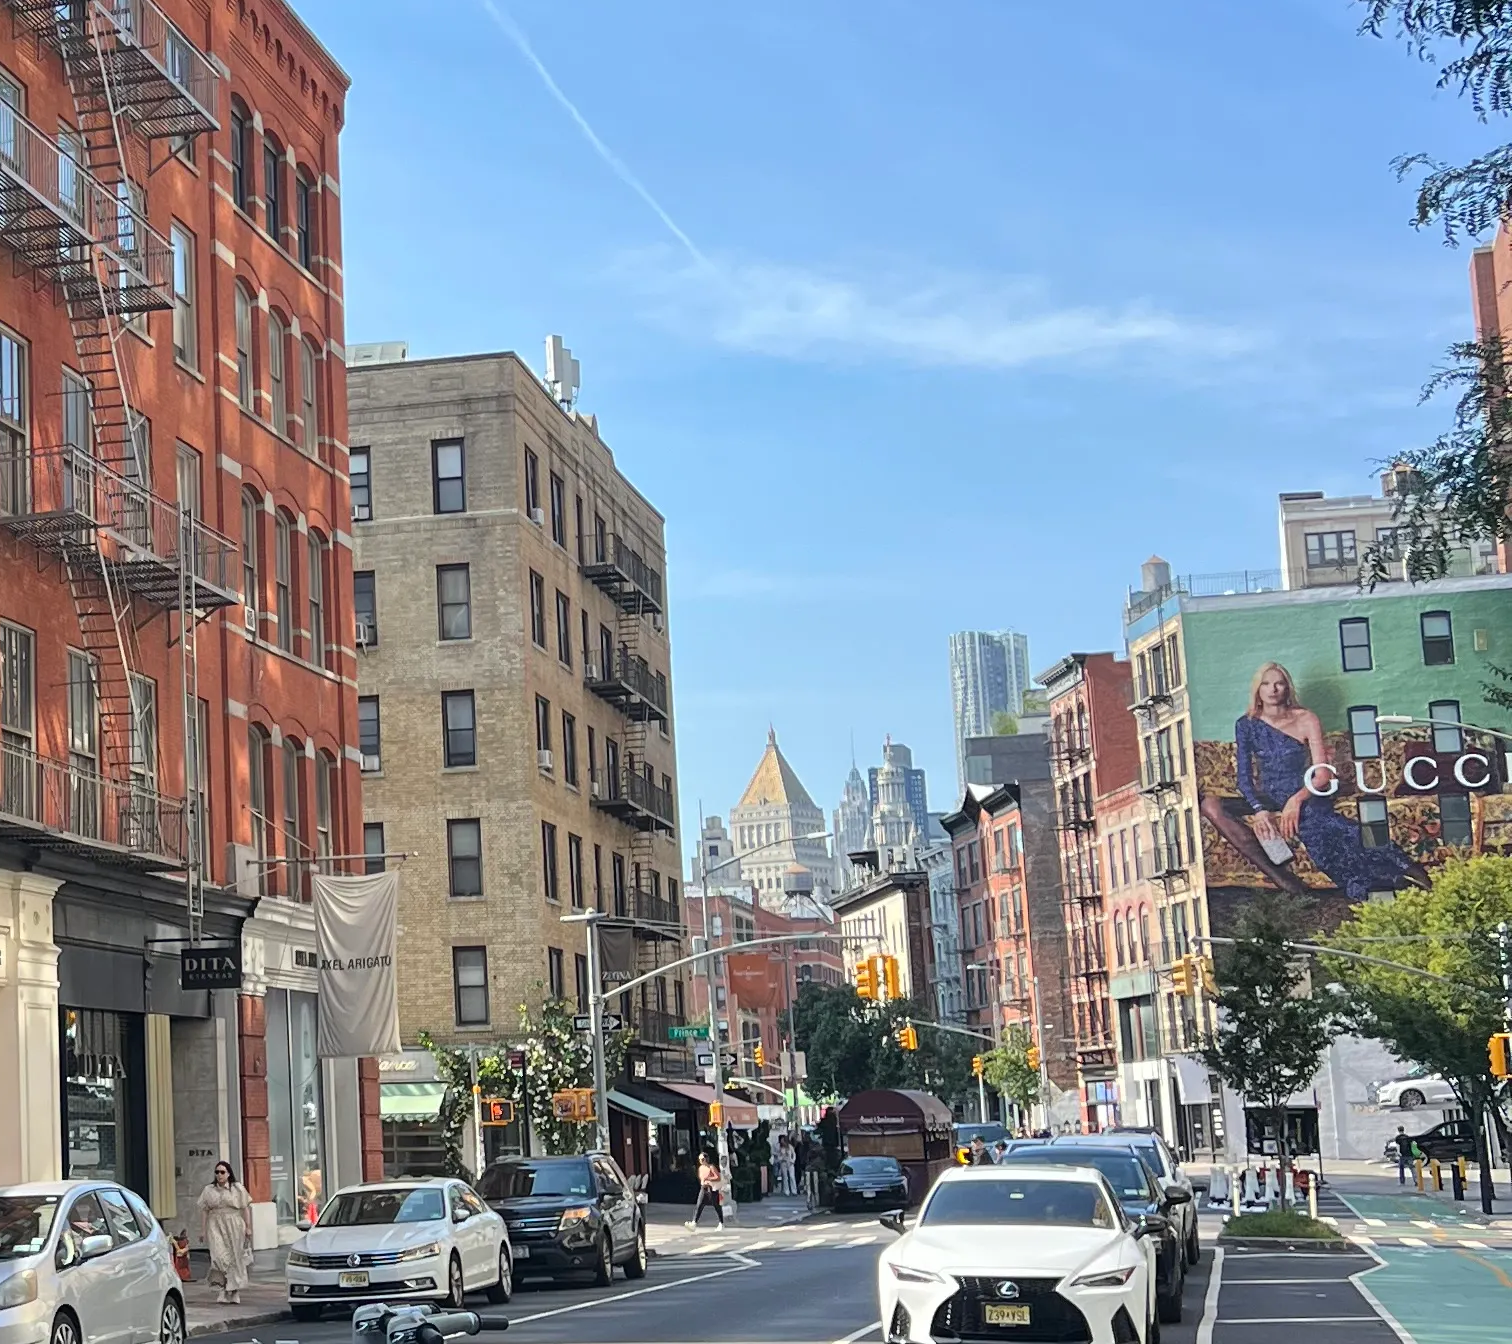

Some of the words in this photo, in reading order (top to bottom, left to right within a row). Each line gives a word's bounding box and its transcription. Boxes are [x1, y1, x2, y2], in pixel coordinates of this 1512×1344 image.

[184, 957, 236, 972] DITA
[674, 1029, 698, 1037] Prince
[189, 1149, 213, 1157] DITA
